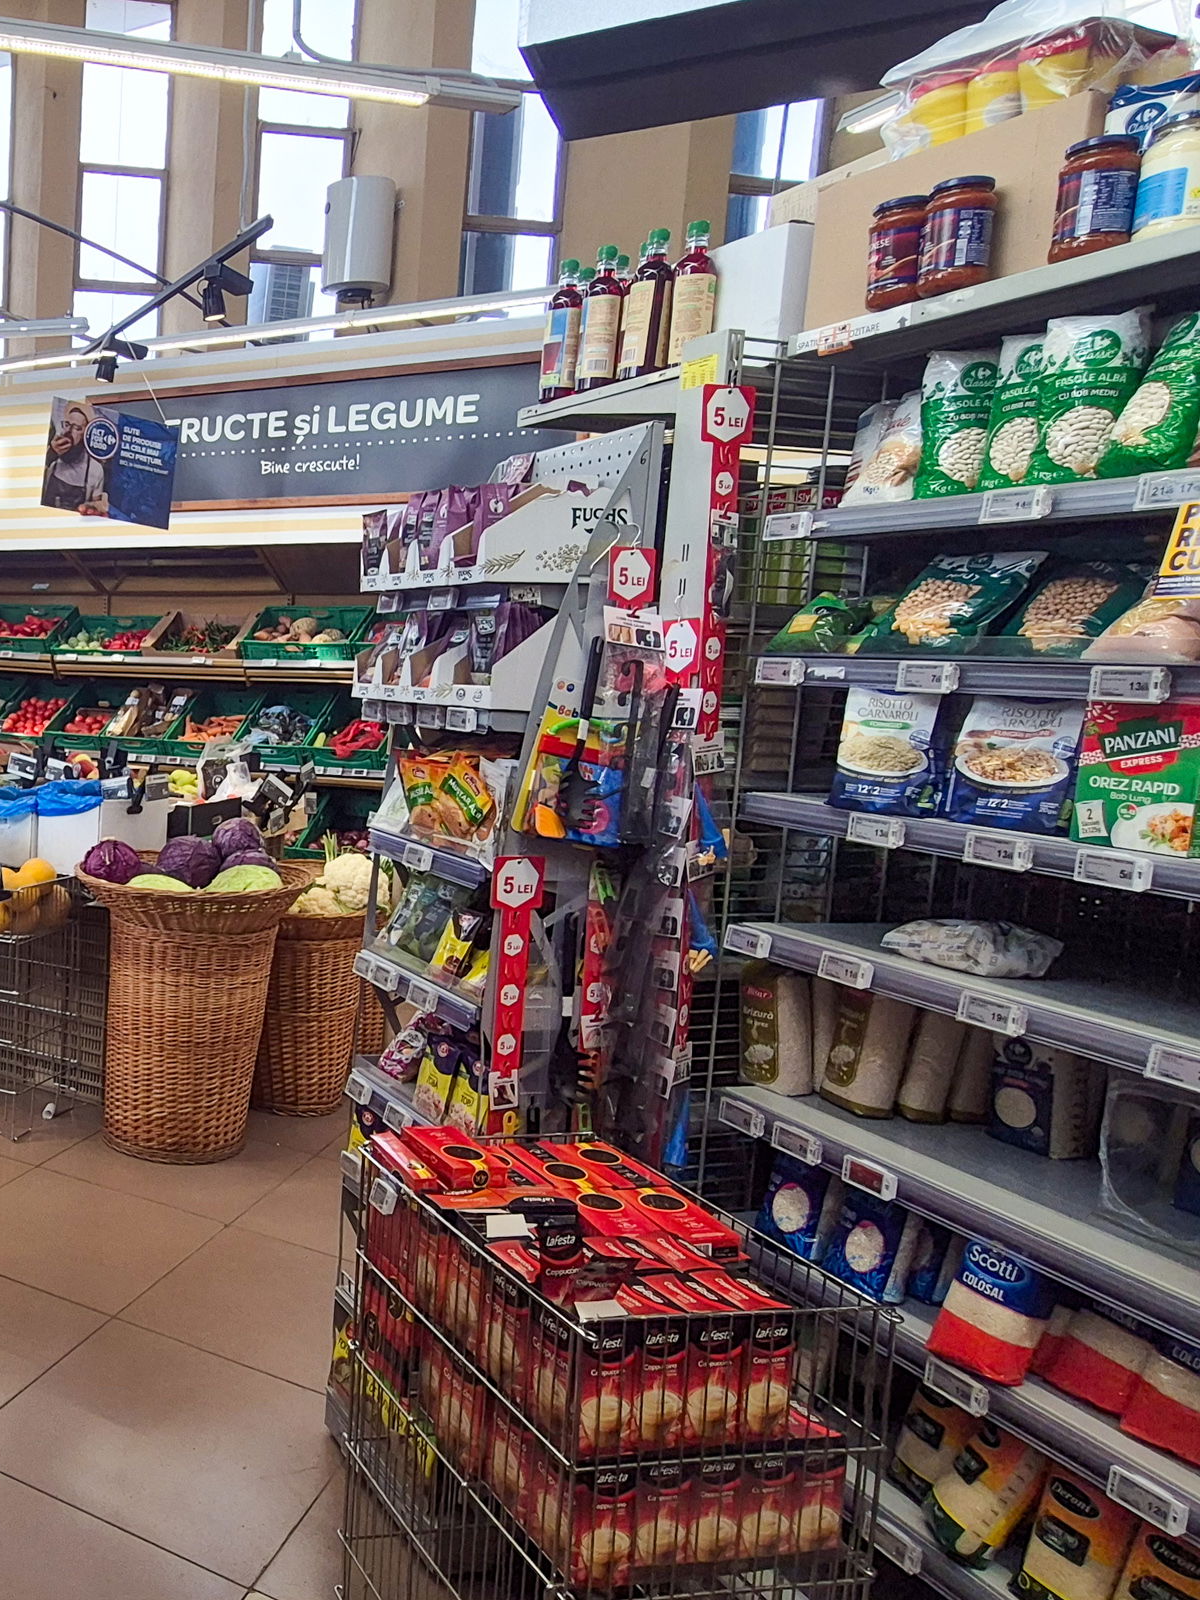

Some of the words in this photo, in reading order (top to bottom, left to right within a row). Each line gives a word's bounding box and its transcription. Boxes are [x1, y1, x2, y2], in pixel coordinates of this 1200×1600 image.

[850, 322, 880, 337] OZITARE
[1055, 373, 1096, 388] FASOLE
[1058, 391, 1070, 400] CU
[1090, 389, 1119, 398] MEDIU
[328, 394, 480, 433] LEGUME
[714, 407, 726, 427] 5
[728, 416, 744, 428] LEI
[92, 428, 105, 438] ACT
[260, 459, 290, 475] Bine
[295, 454, 360, 472] crescute!
[618, 567, 629, 586] 5
[631, 576, 646, 587] LEI
[668, 640, 678, 659] 5
[680, 647, 693, 658] LEI
[707, 644, 713, 654] 5
[704, 699, 710, 708] 5
[868, 698, 913, 710] RISOTTO
[858, 707, 919, 721] CARNAROLI
[1104, 727, 1175, 754] PANZANI
[1120, 755, 1163, 768] EXPRESS
[1089, 776, 1129, 791] OREZ
[1132, 779, 1180, 796] RAPID
[1110, 792, 1127, 800] Bob
[1129, 794, 1152, 803] Lung
[1087, 809, 1093, 819] 2
[503, 876, 514, 894] 5
[517, 884, 533, 894] LEI
[507, 941, 513, 950] 5
[503, 991, 509, 1000] 5
[500, 1041, 506, 1049] 5
[546, 1234, 576, 1247] LaFesta
[969, 1243, 1019, 1282] Scotti
[545, 1268, 581, 1277] Cappuccin
[962, 1271, 1005, 1301] COLOSAL
[1051, 1481, 1092, 1514] Deroni
